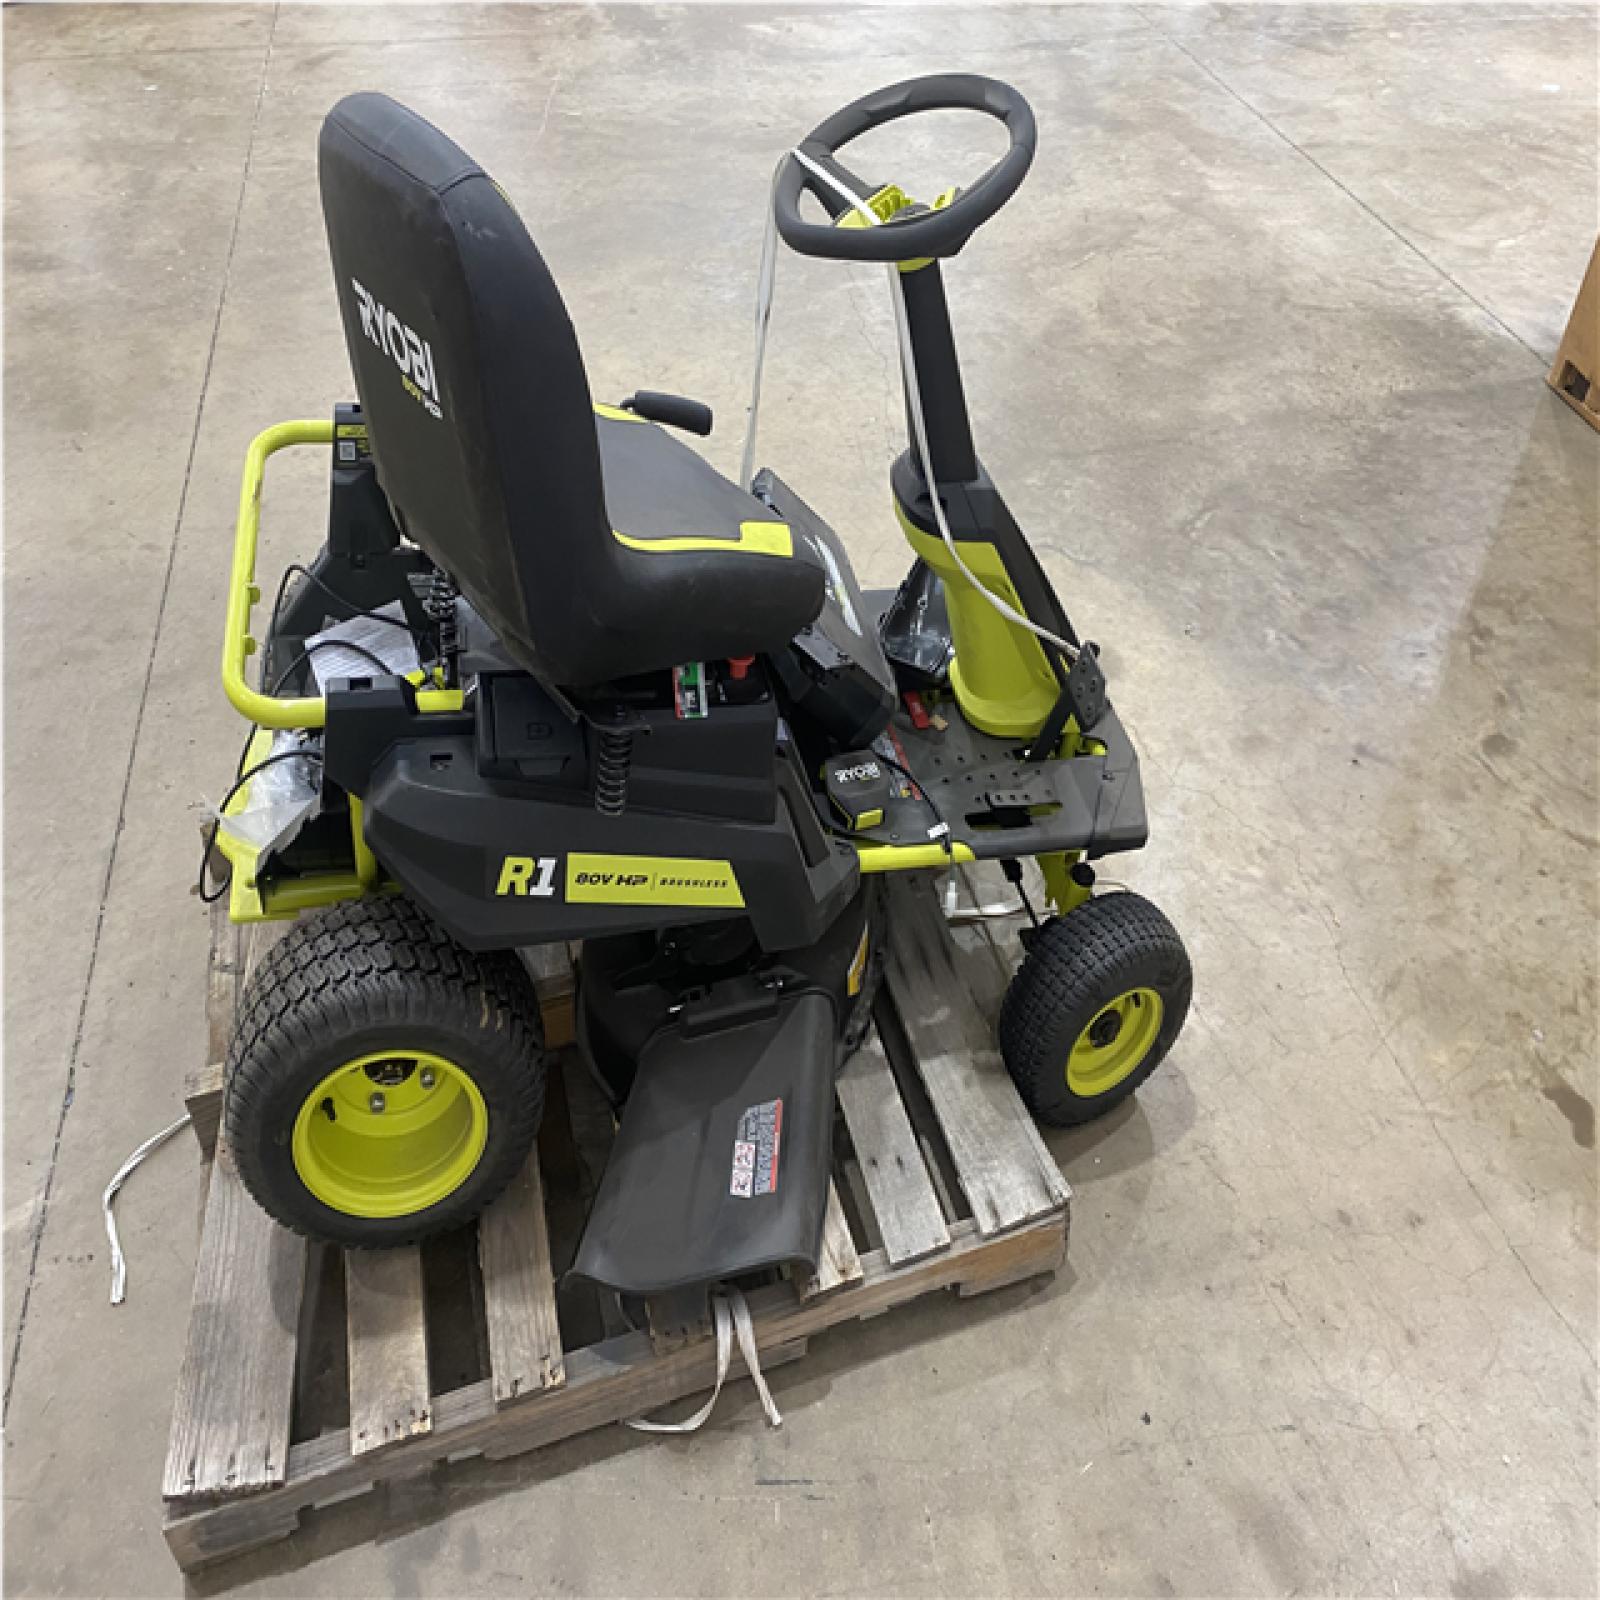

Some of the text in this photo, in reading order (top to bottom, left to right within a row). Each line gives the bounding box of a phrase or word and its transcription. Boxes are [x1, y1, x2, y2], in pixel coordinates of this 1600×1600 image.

[351, 277, 440, 403] RYOBI
[494, 856, 558, 896] R1
[574, 871, 613, 886] 80V
[615, 872, 649, 886] HP
